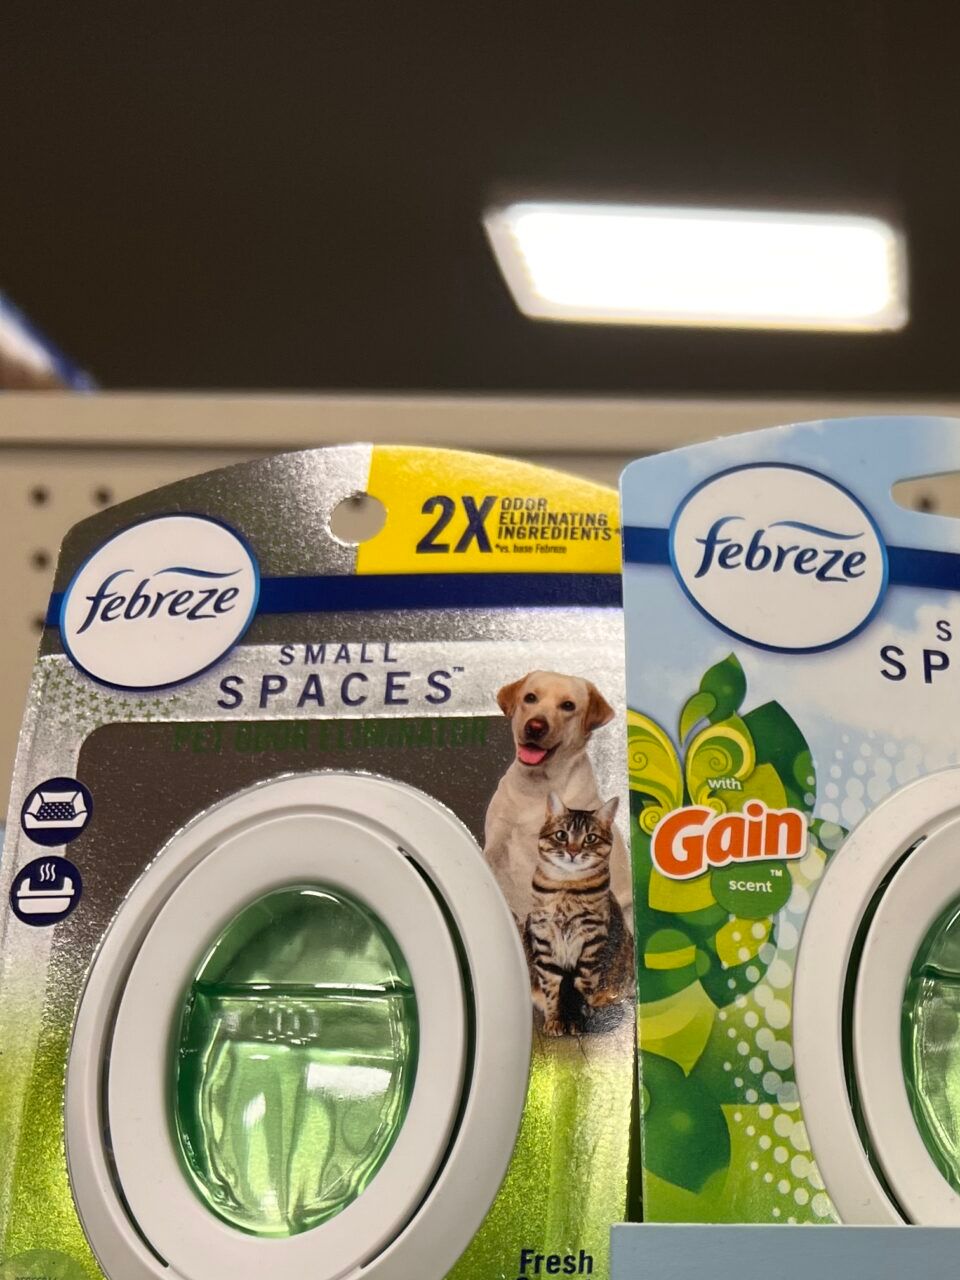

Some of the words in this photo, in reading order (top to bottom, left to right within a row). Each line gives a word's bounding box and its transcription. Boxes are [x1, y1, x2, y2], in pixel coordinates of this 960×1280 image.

[501, 498, 547, 511] ODOR
[416, 495, 498, 554] 2X
[499, 512, 609, 527] ELIMINATING
[695, 515, 867, 583] febreze
[76, 567, 241, 635] febreze
[279, 643, 399, 666] SMALL
[217, 670, 453, 710] SPACES
[708, 778, 742, 791] with
[653, 801, 805, 878] Gain
[729, 880, 773, 893] scent
[520, 1249, 593, 1275] Fresh
